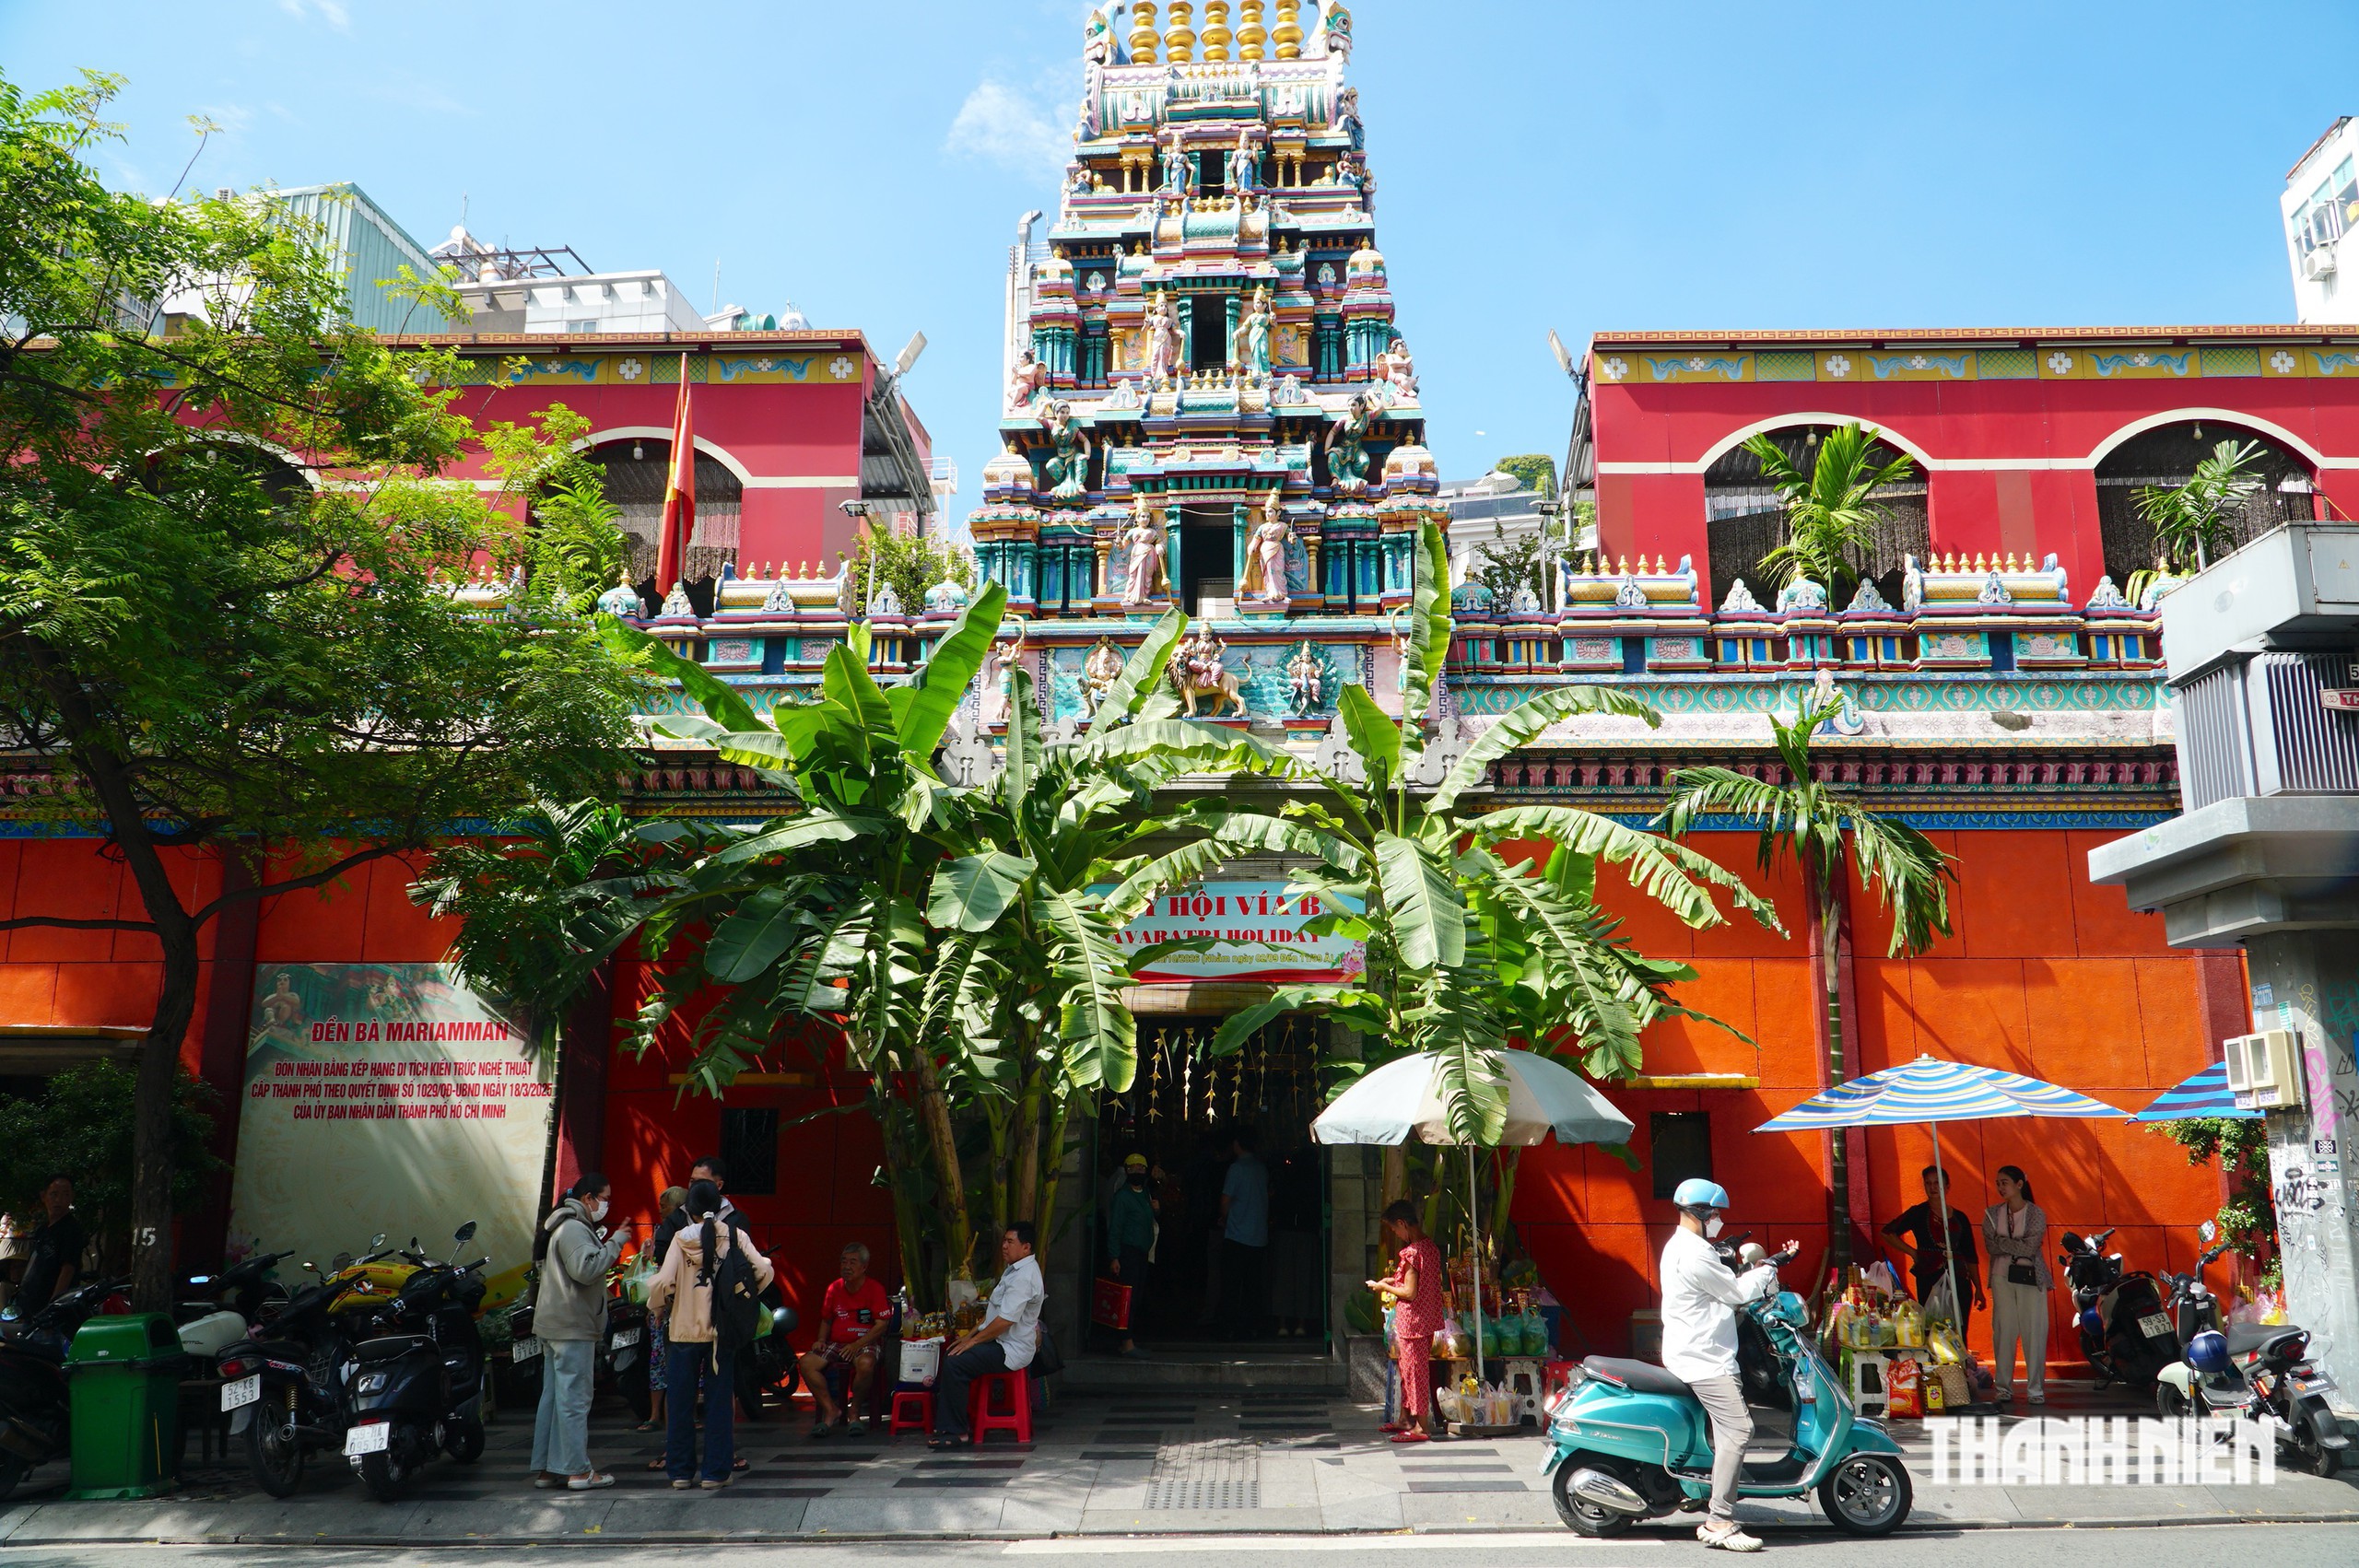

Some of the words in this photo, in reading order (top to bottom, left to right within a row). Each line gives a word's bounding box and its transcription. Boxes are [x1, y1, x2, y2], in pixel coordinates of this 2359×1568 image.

[1168, 891, 1226, 922] HỘI
[1235, 890, 1292, 916] VÍA
[1299, 895, 1332, 916] B
[1110, 930, 1221, 944] AVARATRI
[1226, 929, 1320, 943] HOLIDAY
[311, 1015, 350, 1042] ĐỀN
[355, 1018, 380, 1042] BÀ
[385, 1021, 509, 1042] MARIAMMAN
[275, 1059, 295, 1076] ĐÓN
[296, 1059, 322, 1080] NHẬN
[350, 1058, 369, 1076] XẾP
[370, 1062, 395, 1080] HẠNG
[397, 1062, 406, 1076] DI
[408, 1059, 428, 1076] TÍCH
[430, 1058, 452, 1076] KIẾN
[453, 1059, 476, 1076] TRÚC
[505, 1059, 533, 1079] THUẬT
[251, 1079, 270, 1097] CẤP
[272, 1080, 301, 1097] THÀNH
[303, 1079, 323, 1097] PHỐ
[323, 1083, 346, 1097] THEO
[348, 1079, 376, 1099] QUYẾT
[377, 1083, 400, 1101] ĐỊNH
[402, 1078, 415, 1097] SỐ
[417, 1082, 480, 1098] 1029/QĐ-UBND
[482, 1080, 508, 1097] NGÀY
[509, 1082, 552, 1097] 18/3/2025
[293, 1100, 311, 1119] CỦA
[313, 1100, 326, 1119] ỦY
[327, 1105, 348, 1119] BAN
[348, 1102, 375, 1119] NHÂN
[376, 1102, 395, 1119] DÂN
[398, 1102, 428, 1118] THÀNH
[429, 1099, 449, 1118] PHỐ
[464, 1101, 480, 1118] CHÍ
[481, 1105, 507, 1118] MINH
[133, 1227, 156, 1246] 15
[2142, 1315, 2166, 1327] 59-S3
[2144, 1322, 2172, 1337] 018.27
[518, 1345, 538, 1360] 7140
[229, 1378, 253, 1396] 52-K8
[229, 1389, 253, 1408] 1553
